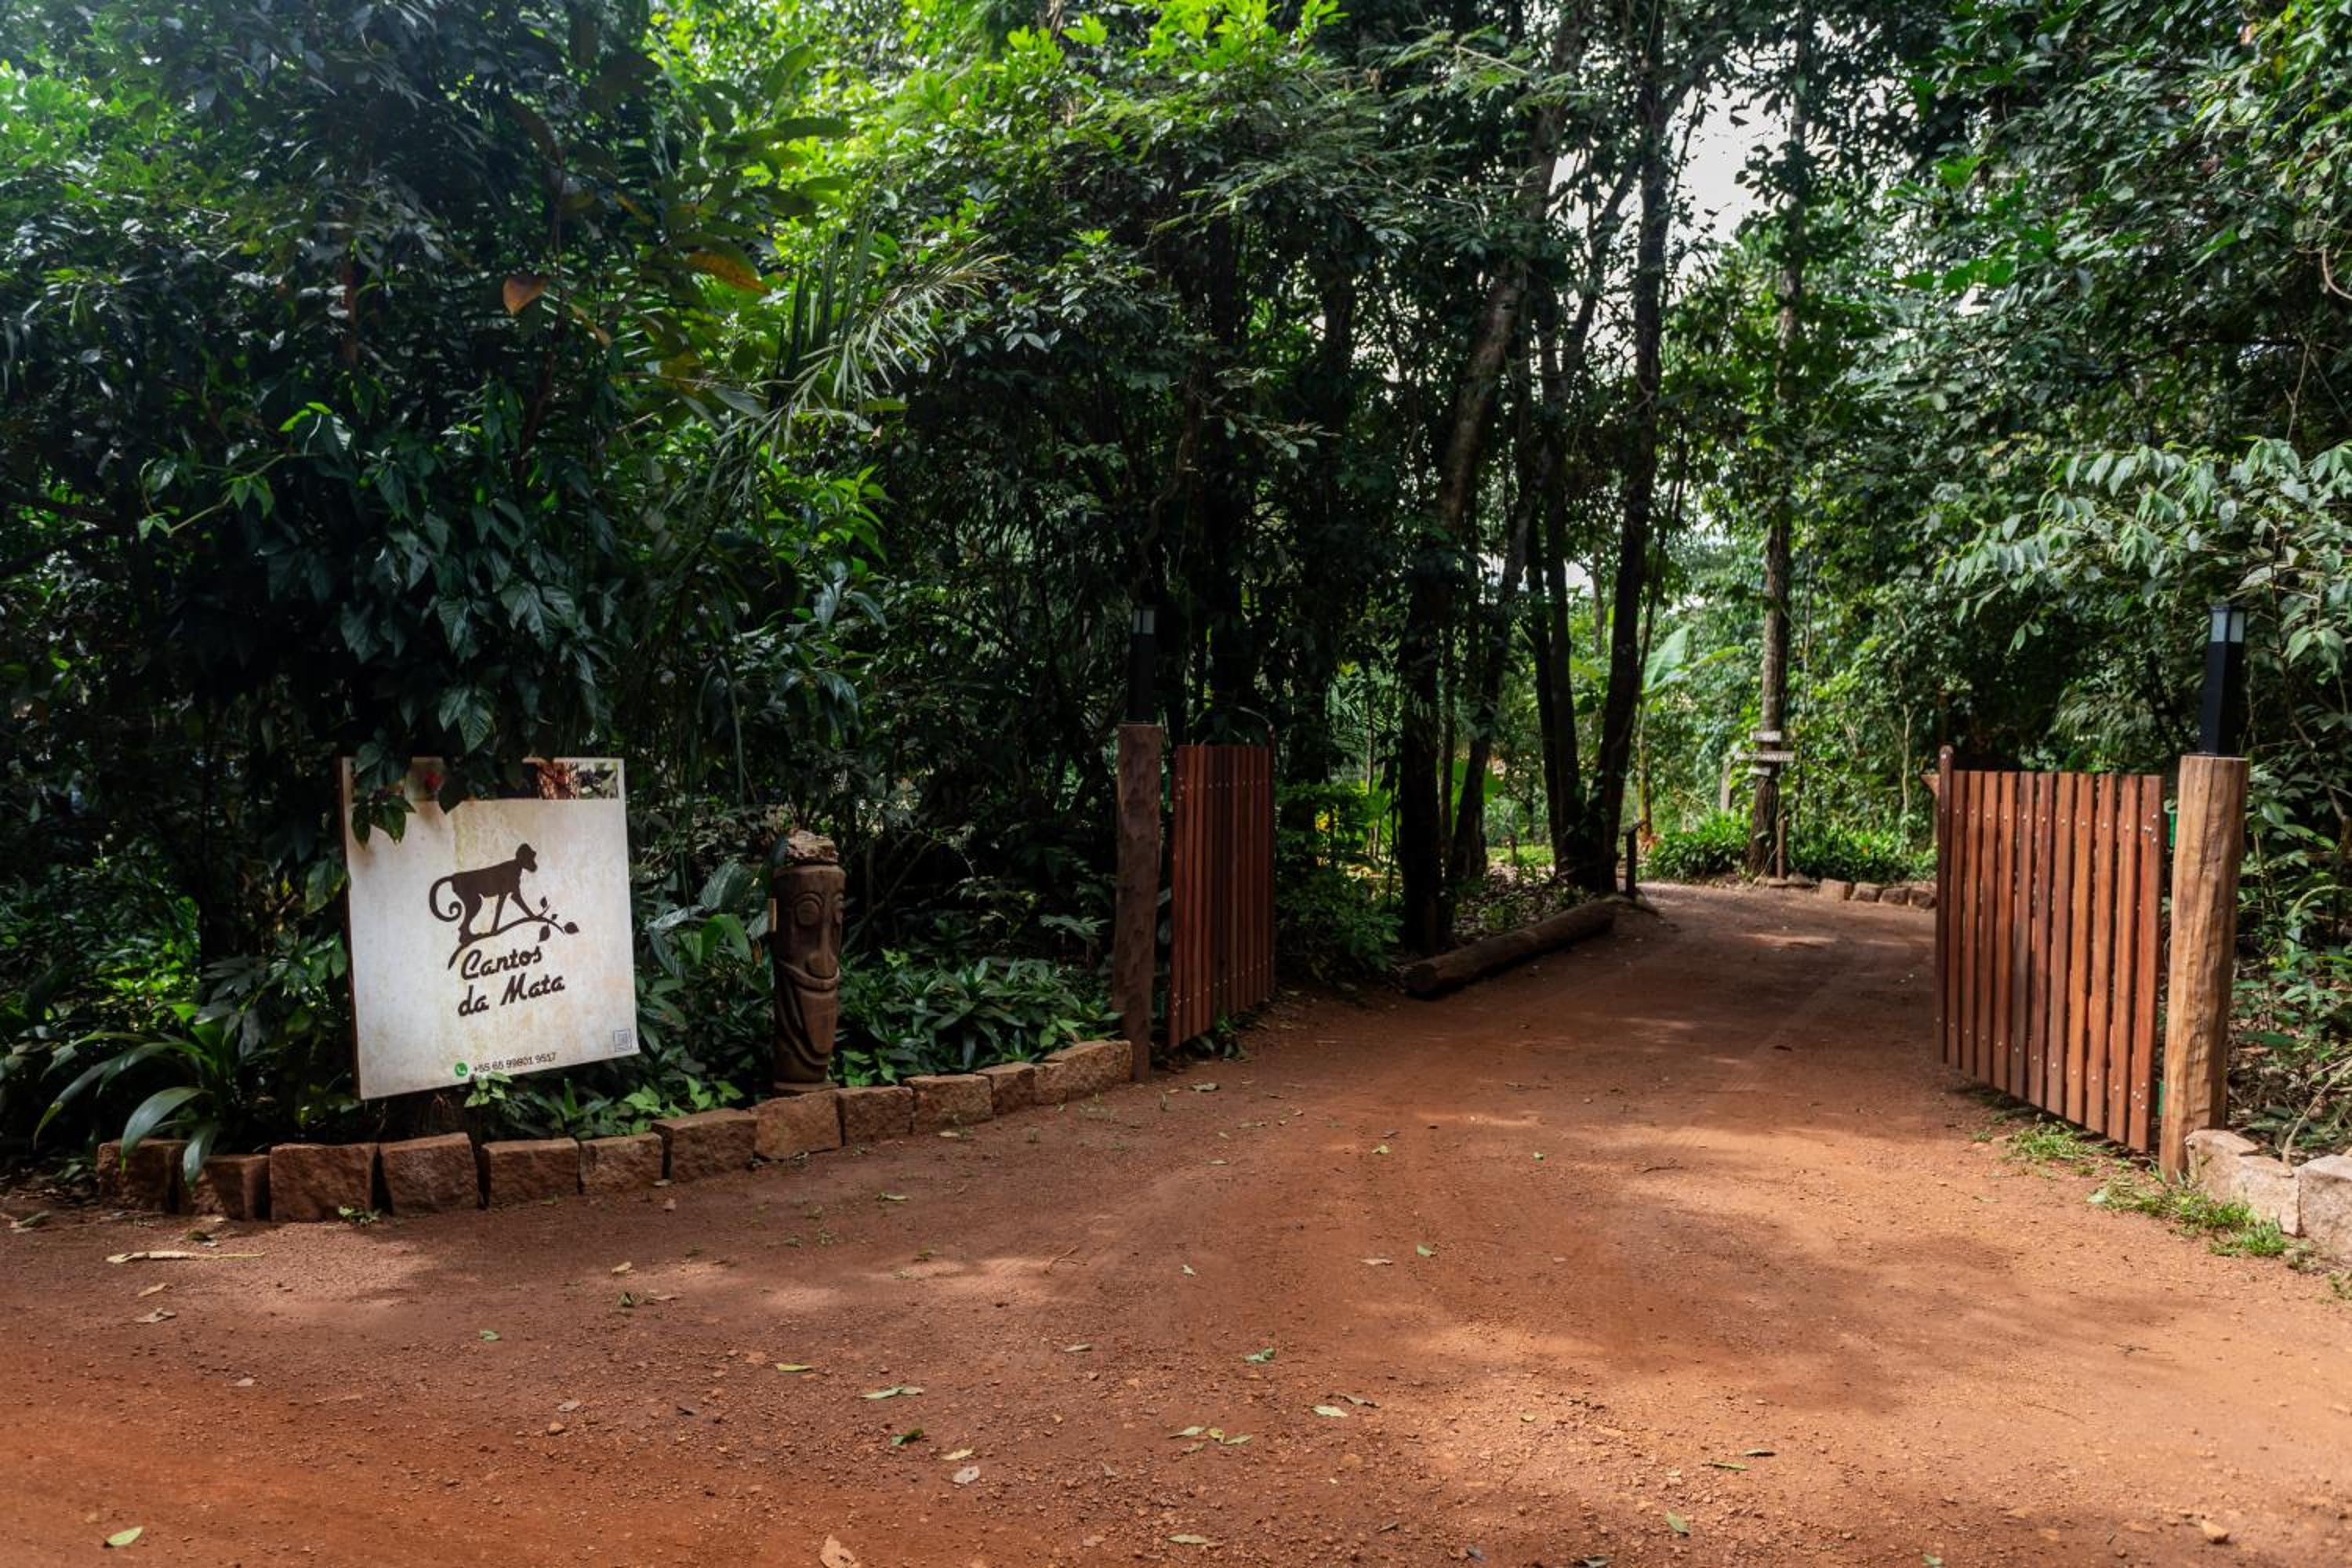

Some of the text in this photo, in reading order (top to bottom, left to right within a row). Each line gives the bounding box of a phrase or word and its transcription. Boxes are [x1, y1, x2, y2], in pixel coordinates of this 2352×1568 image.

[461, 946, 543, 980] Cantos
[458, 973, 565, 1016] da Mata
[474, 1062, 491, 1073] +55
